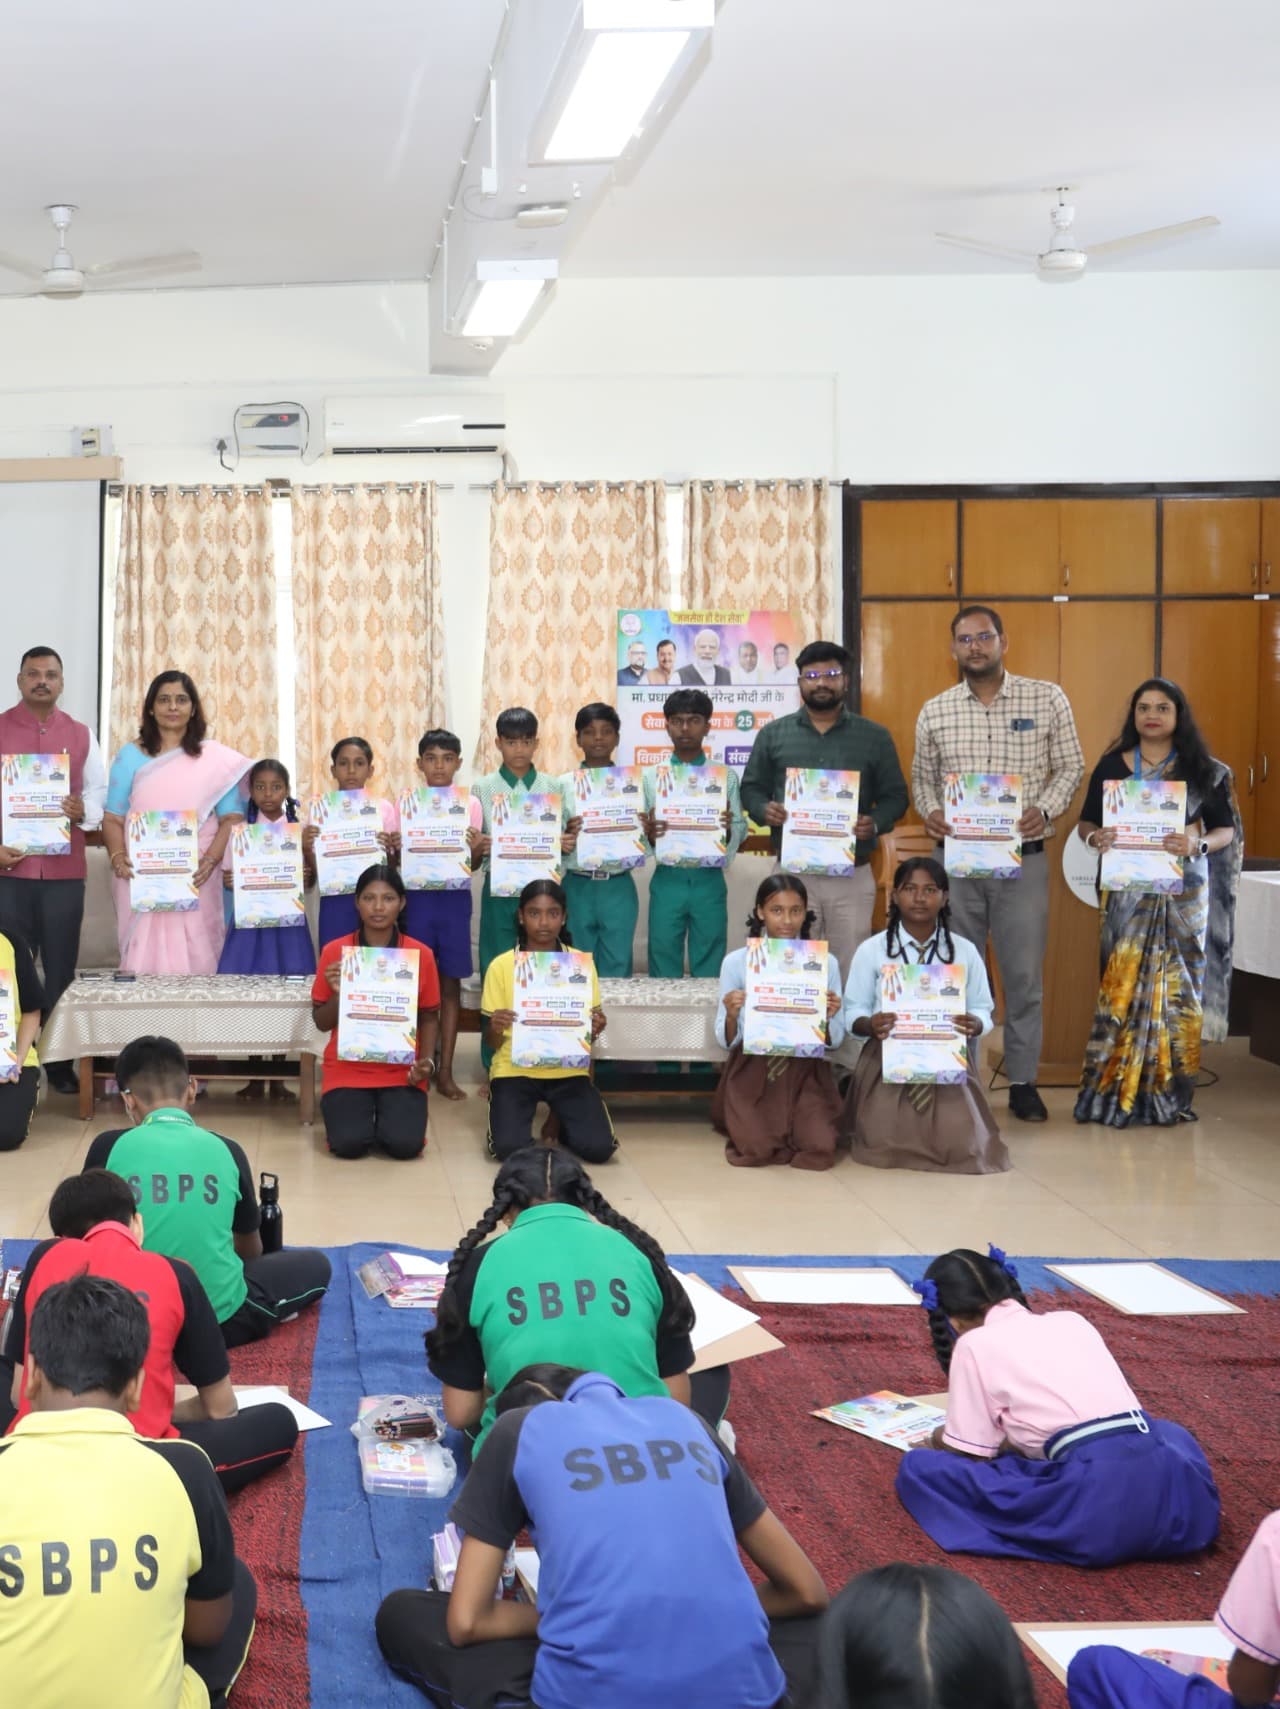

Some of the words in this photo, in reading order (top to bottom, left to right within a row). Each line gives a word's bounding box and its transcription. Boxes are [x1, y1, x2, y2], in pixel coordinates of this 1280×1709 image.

[738, 716, 753, 728] 25
[128, 1173, 220, 1206] SBPS
[506, 1278, 631, 1326] SBPS
[564, 1439, 719, 1492] SBPS
